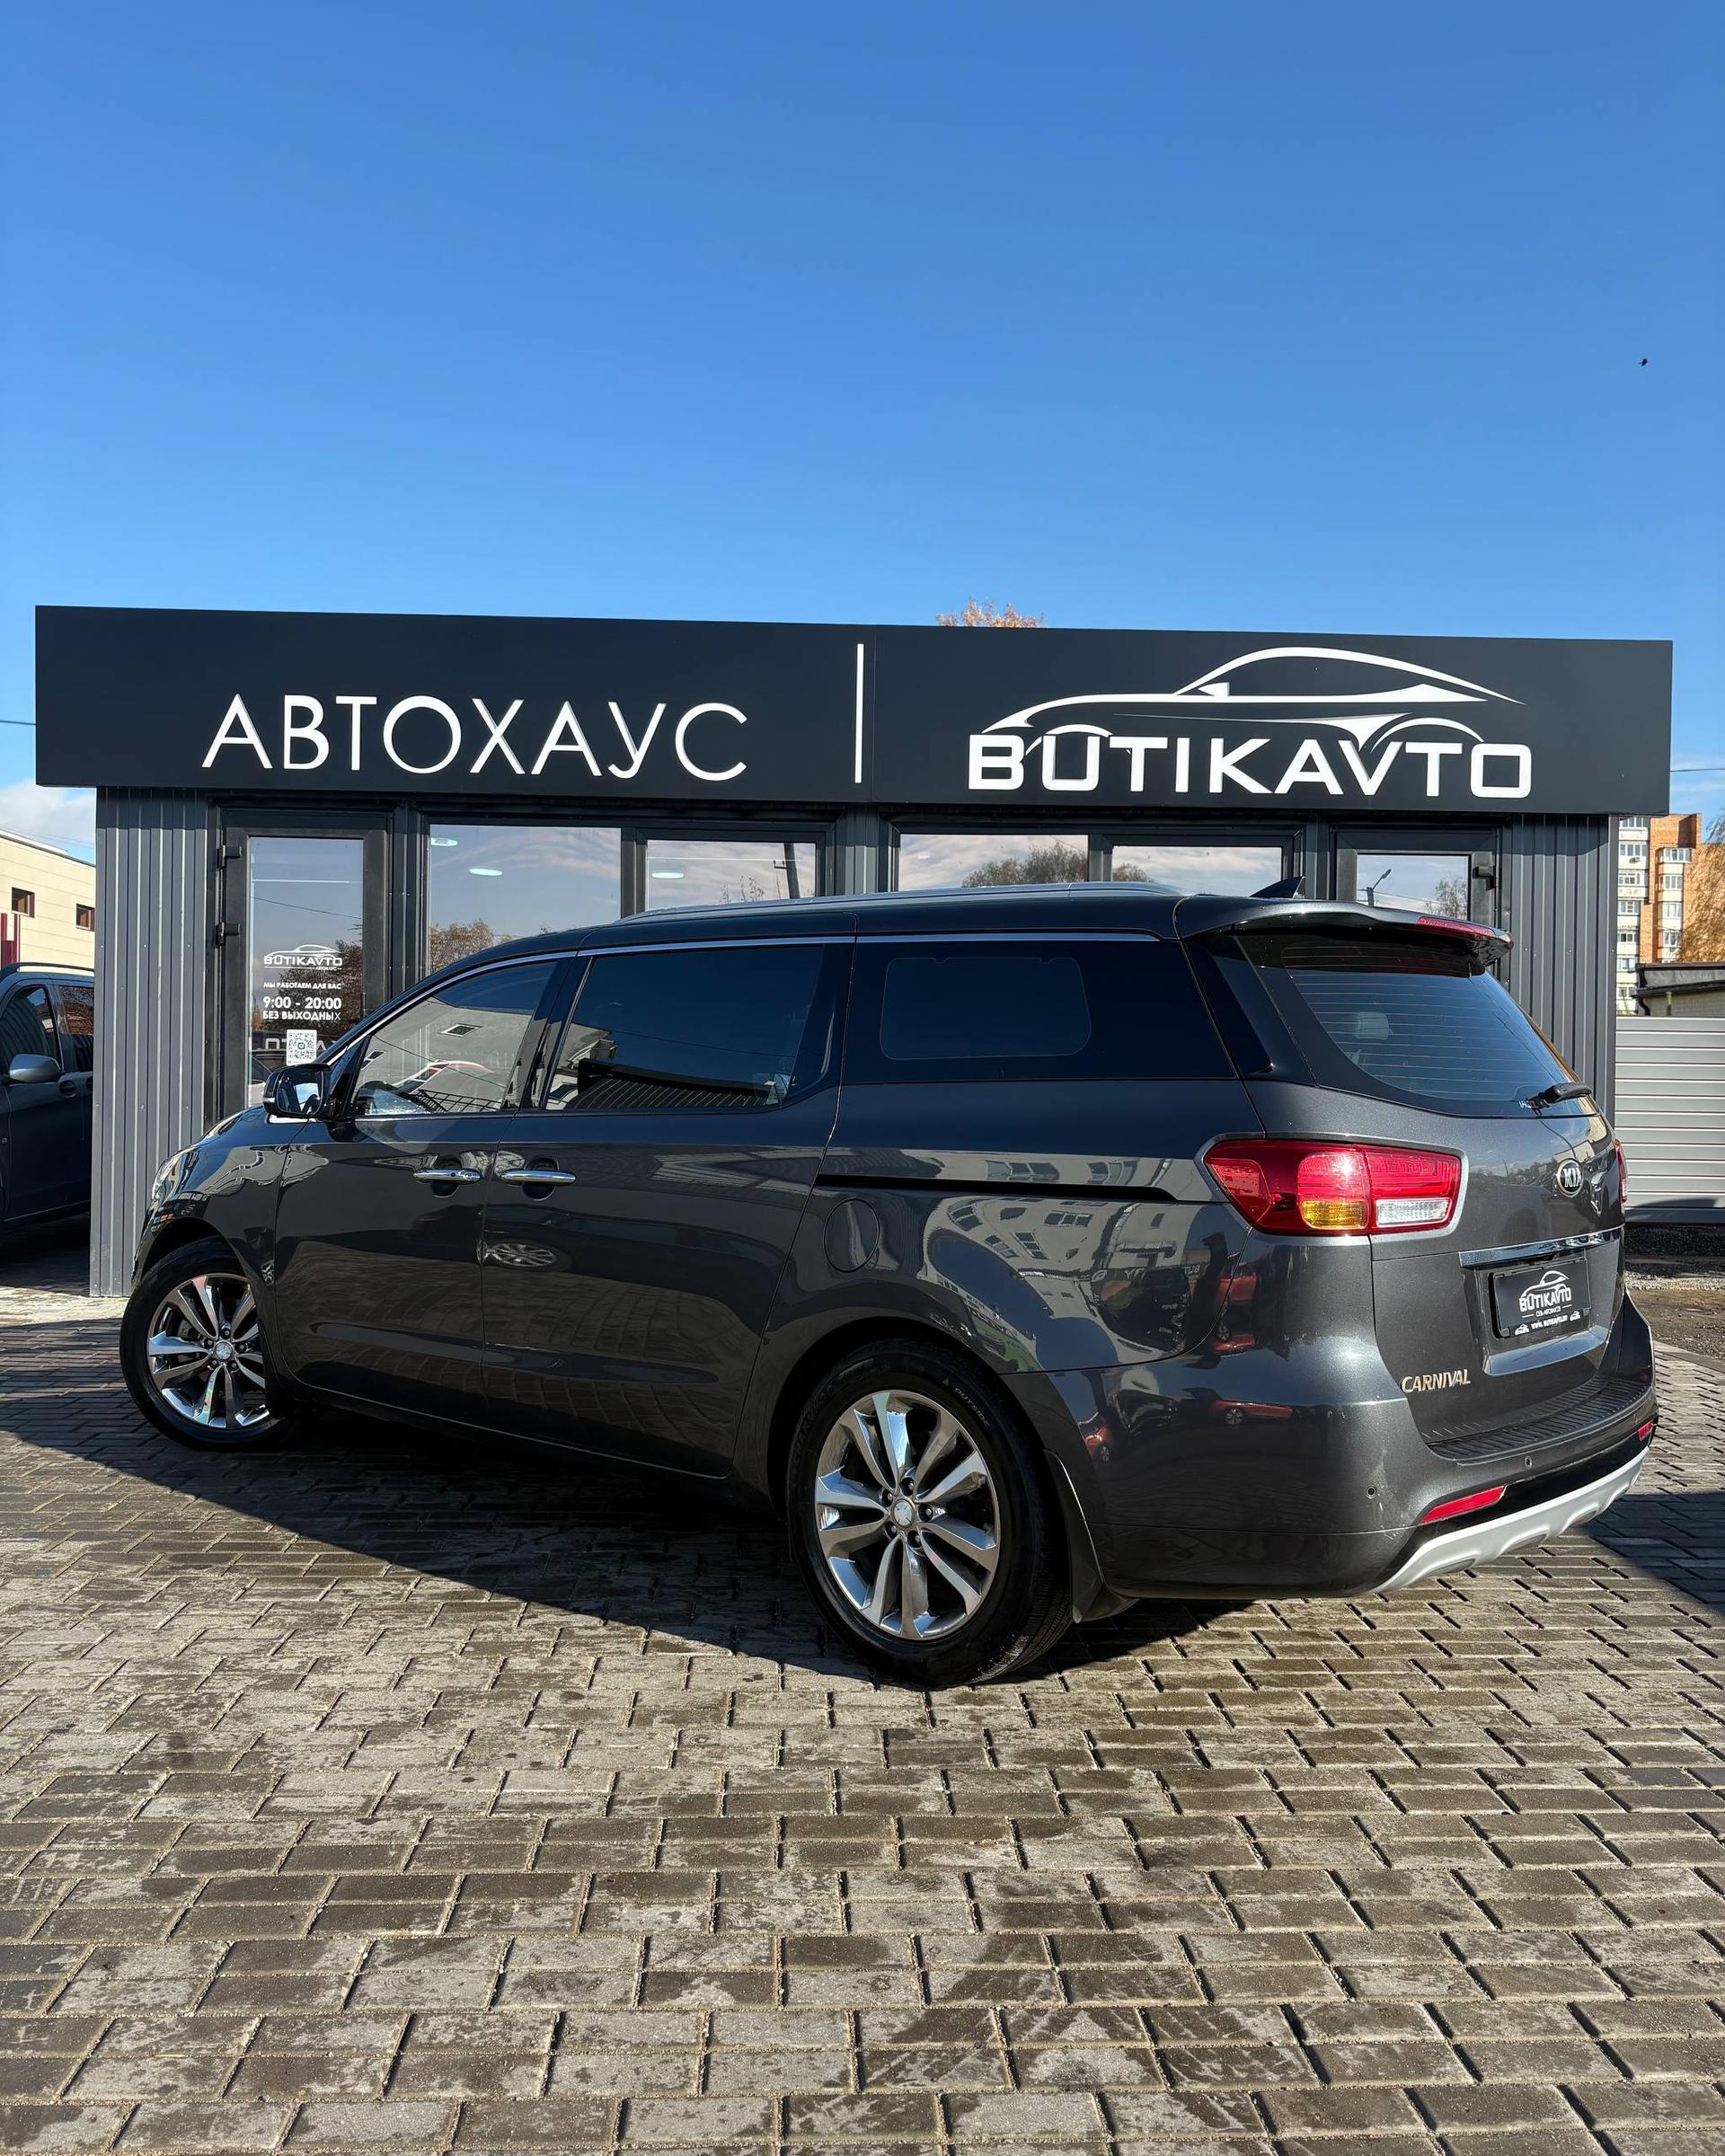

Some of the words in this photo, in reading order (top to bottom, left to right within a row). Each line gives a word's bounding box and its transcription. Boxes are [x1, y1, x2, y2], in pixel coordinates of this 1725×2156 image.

[202, 694, 748, 782] АВТОХАУС
[968, 733, 1533, 800] BUTIKAVTO
[263, 955, 343, 967] BUTIKAVTO
[262, 995, 291, 1009] 9:00
[305, 996, 342, 1010] 20:00
[262, 1010, 279, 1020] БЕЗ
[281, 1011, 341, 1021] ВЫХОДНЫХ
[1518, 1286, 1572, 1312] BUTIKAVTO
[1402, 1368, 1472, 1393] CARNIVAL
